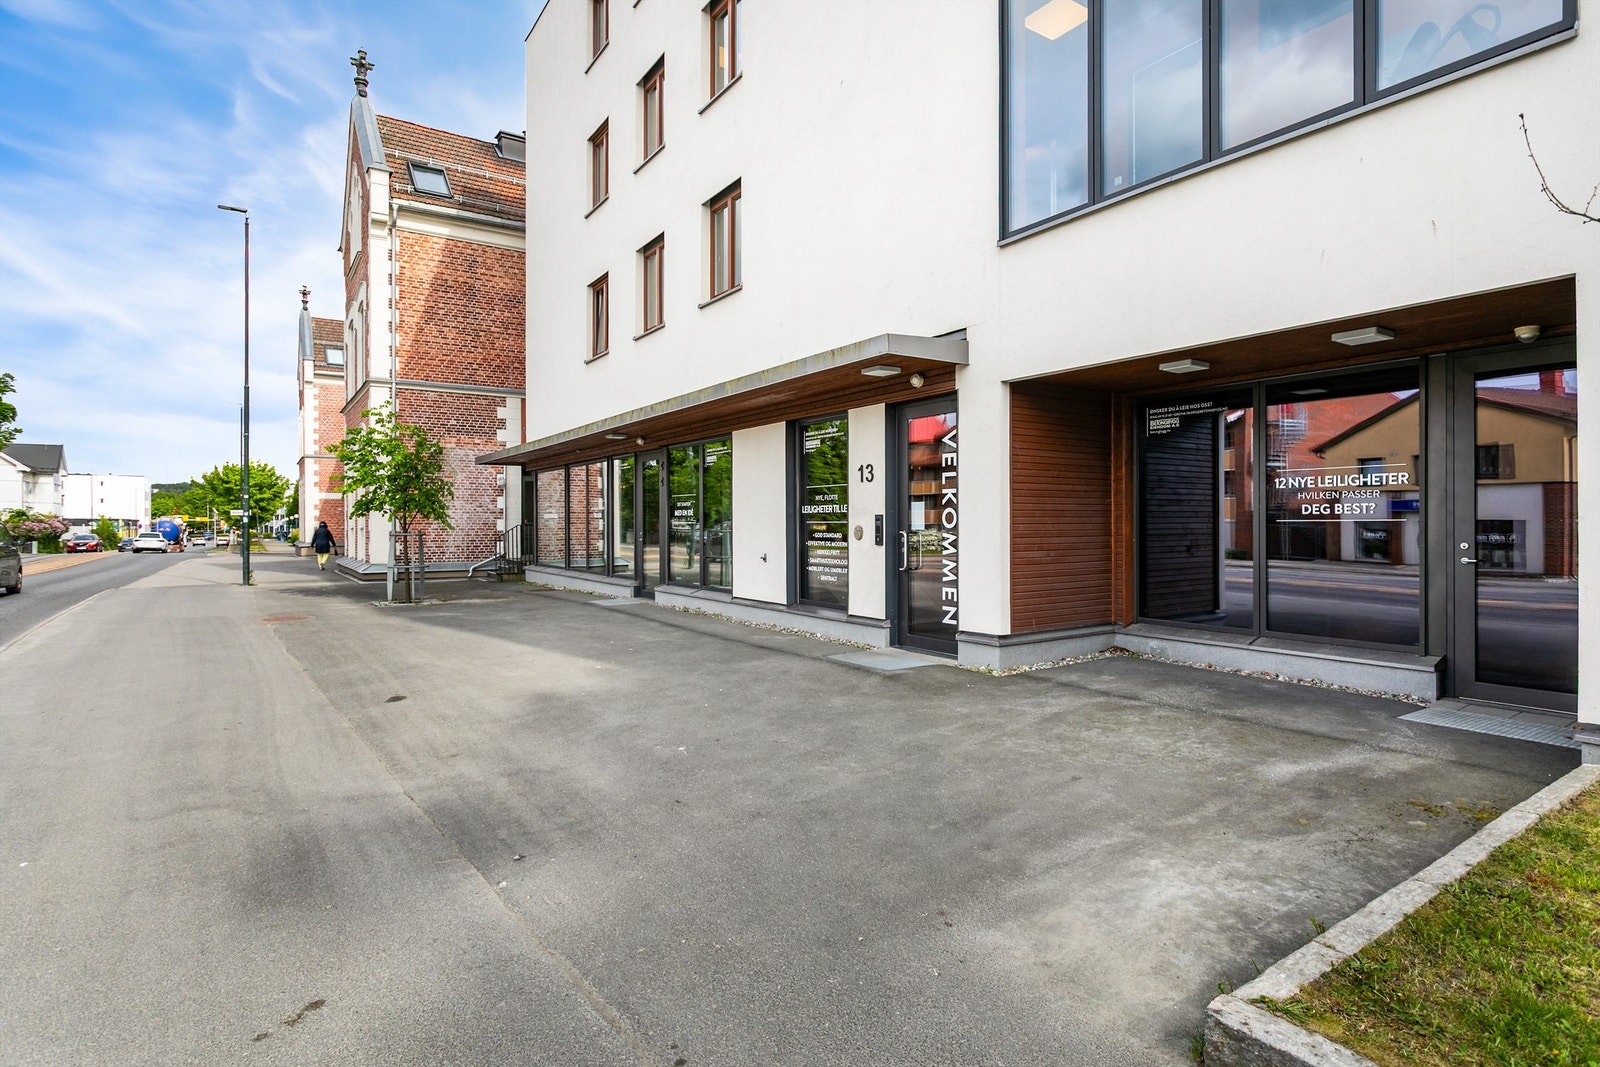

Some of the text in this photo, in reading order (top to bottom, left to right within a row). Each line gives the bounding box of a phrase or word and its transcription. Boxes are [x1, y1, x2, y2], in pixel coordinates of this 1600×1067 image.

[858, 463, 874, 483] 13
[1274, 472, 1410, 489] 12 NYE LEILIGHETER
[1298, 489, 1380, 500] HVILKEN PASSER
[802, 504, 832, 514] LEILIGHETER
[1302, 502, 1376, 514] DEG BEST?
[942, 428, 958, 626] VELKOMMEN
